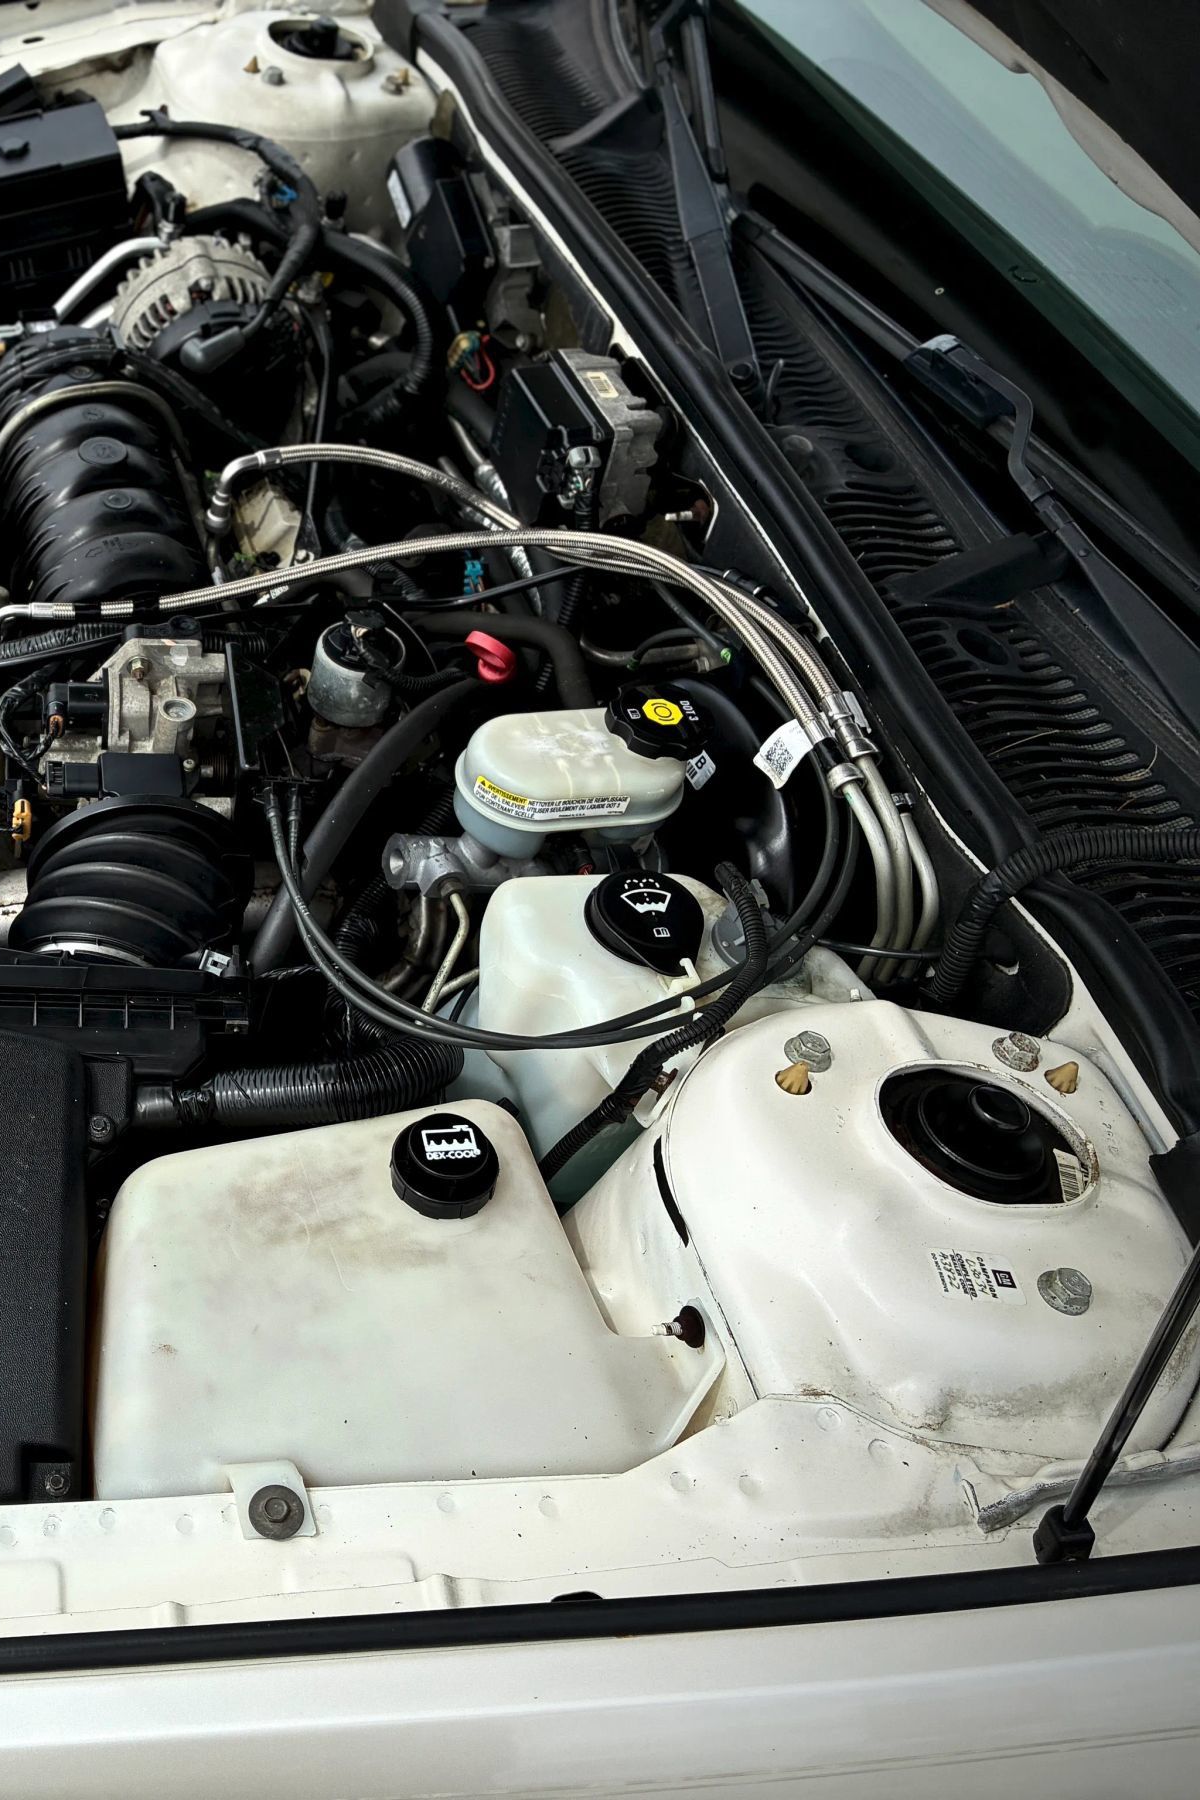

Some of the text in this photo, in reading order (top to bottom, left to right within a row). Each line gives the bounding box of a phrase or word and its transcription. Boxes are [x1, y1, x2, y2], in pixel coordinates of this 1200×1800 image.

[680, 700, 696, 715] DOT
[694, 755, 706, 770] B
[488, 785, 527, 804] AVERTISSEMENT
[486, 798, 513, 814] CONTENANT
[938, 1272, 949, 1293] REMOVE
[949, 1254, 969, 1295] DEALER CODE
[955, 1253, 978, 1298] COMPLETED
[976, 1257, 998, 1299] CAMPAIGN
